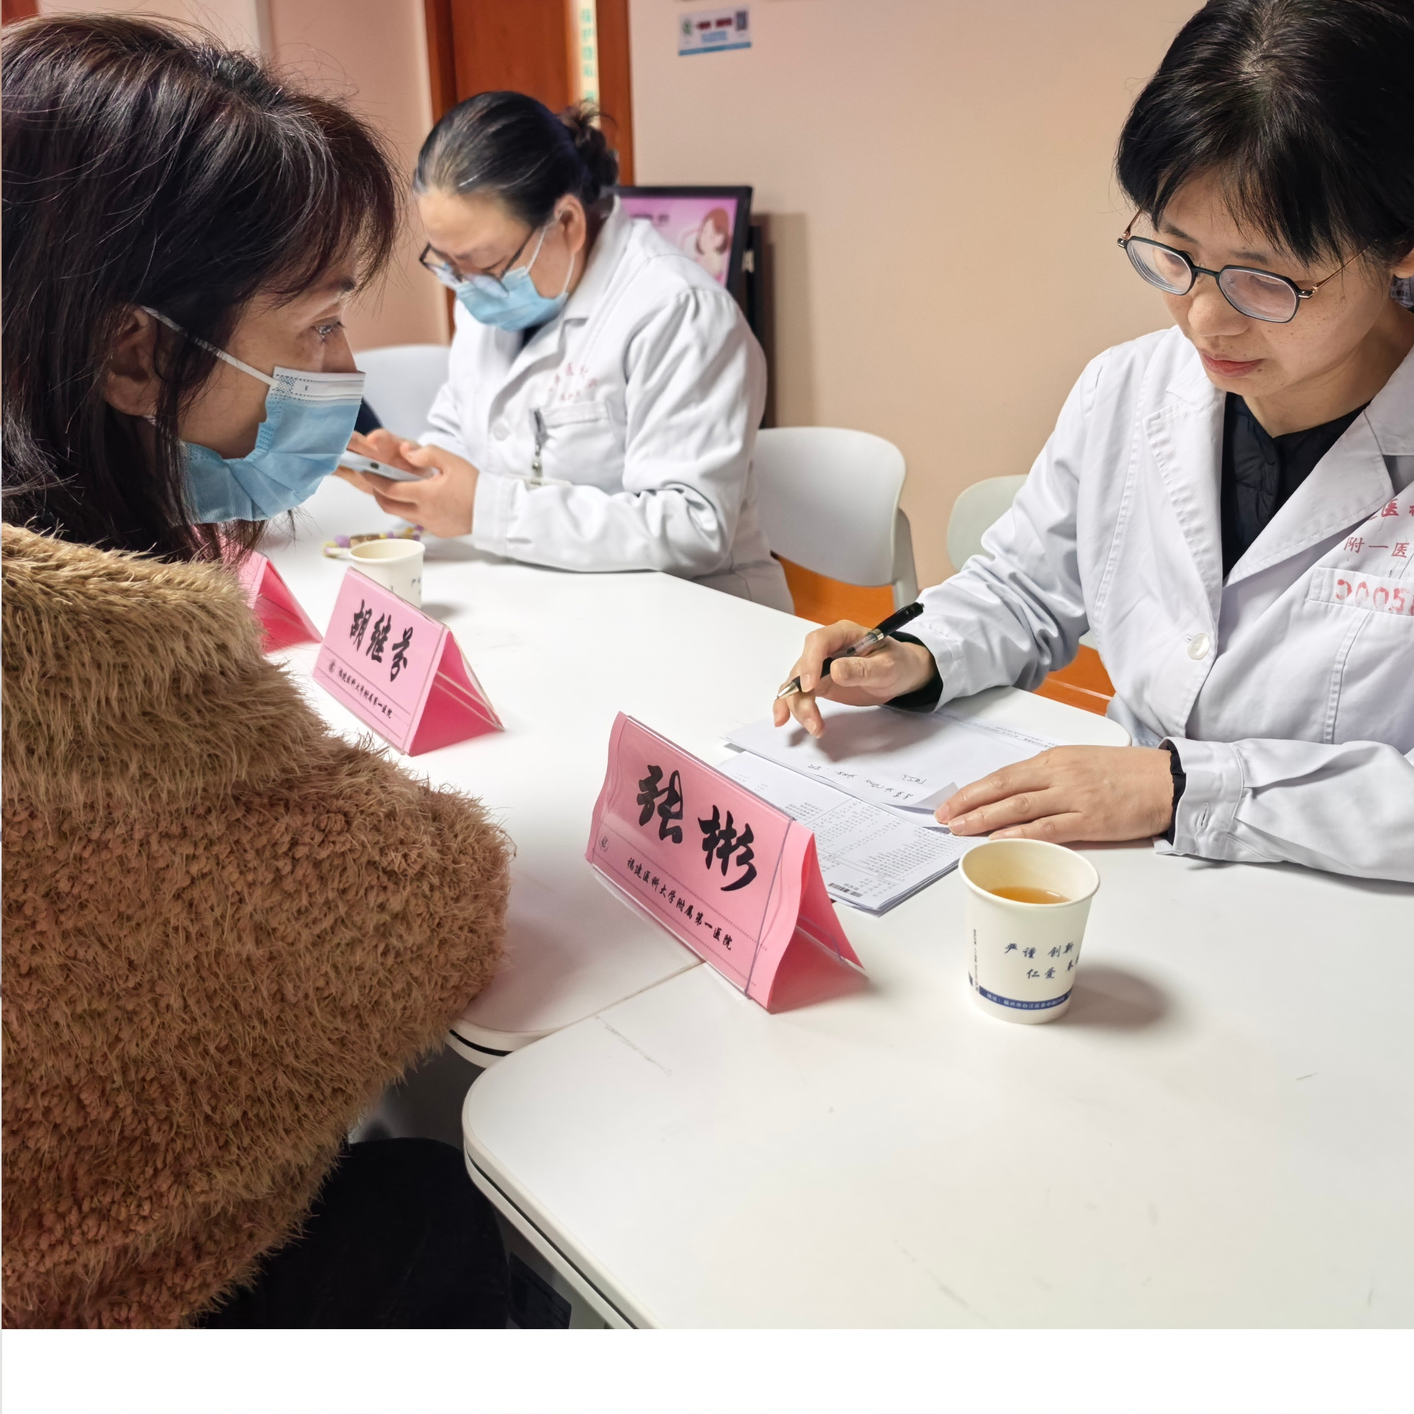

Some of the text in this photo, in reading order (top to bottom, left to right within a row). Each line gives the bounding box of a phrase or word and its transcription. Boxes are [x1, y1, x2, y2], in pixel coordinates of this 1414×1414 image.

[635, 763, 759, 892] 张彬
[627, 856, 735, 953] 福建医科大学附属第一医院
